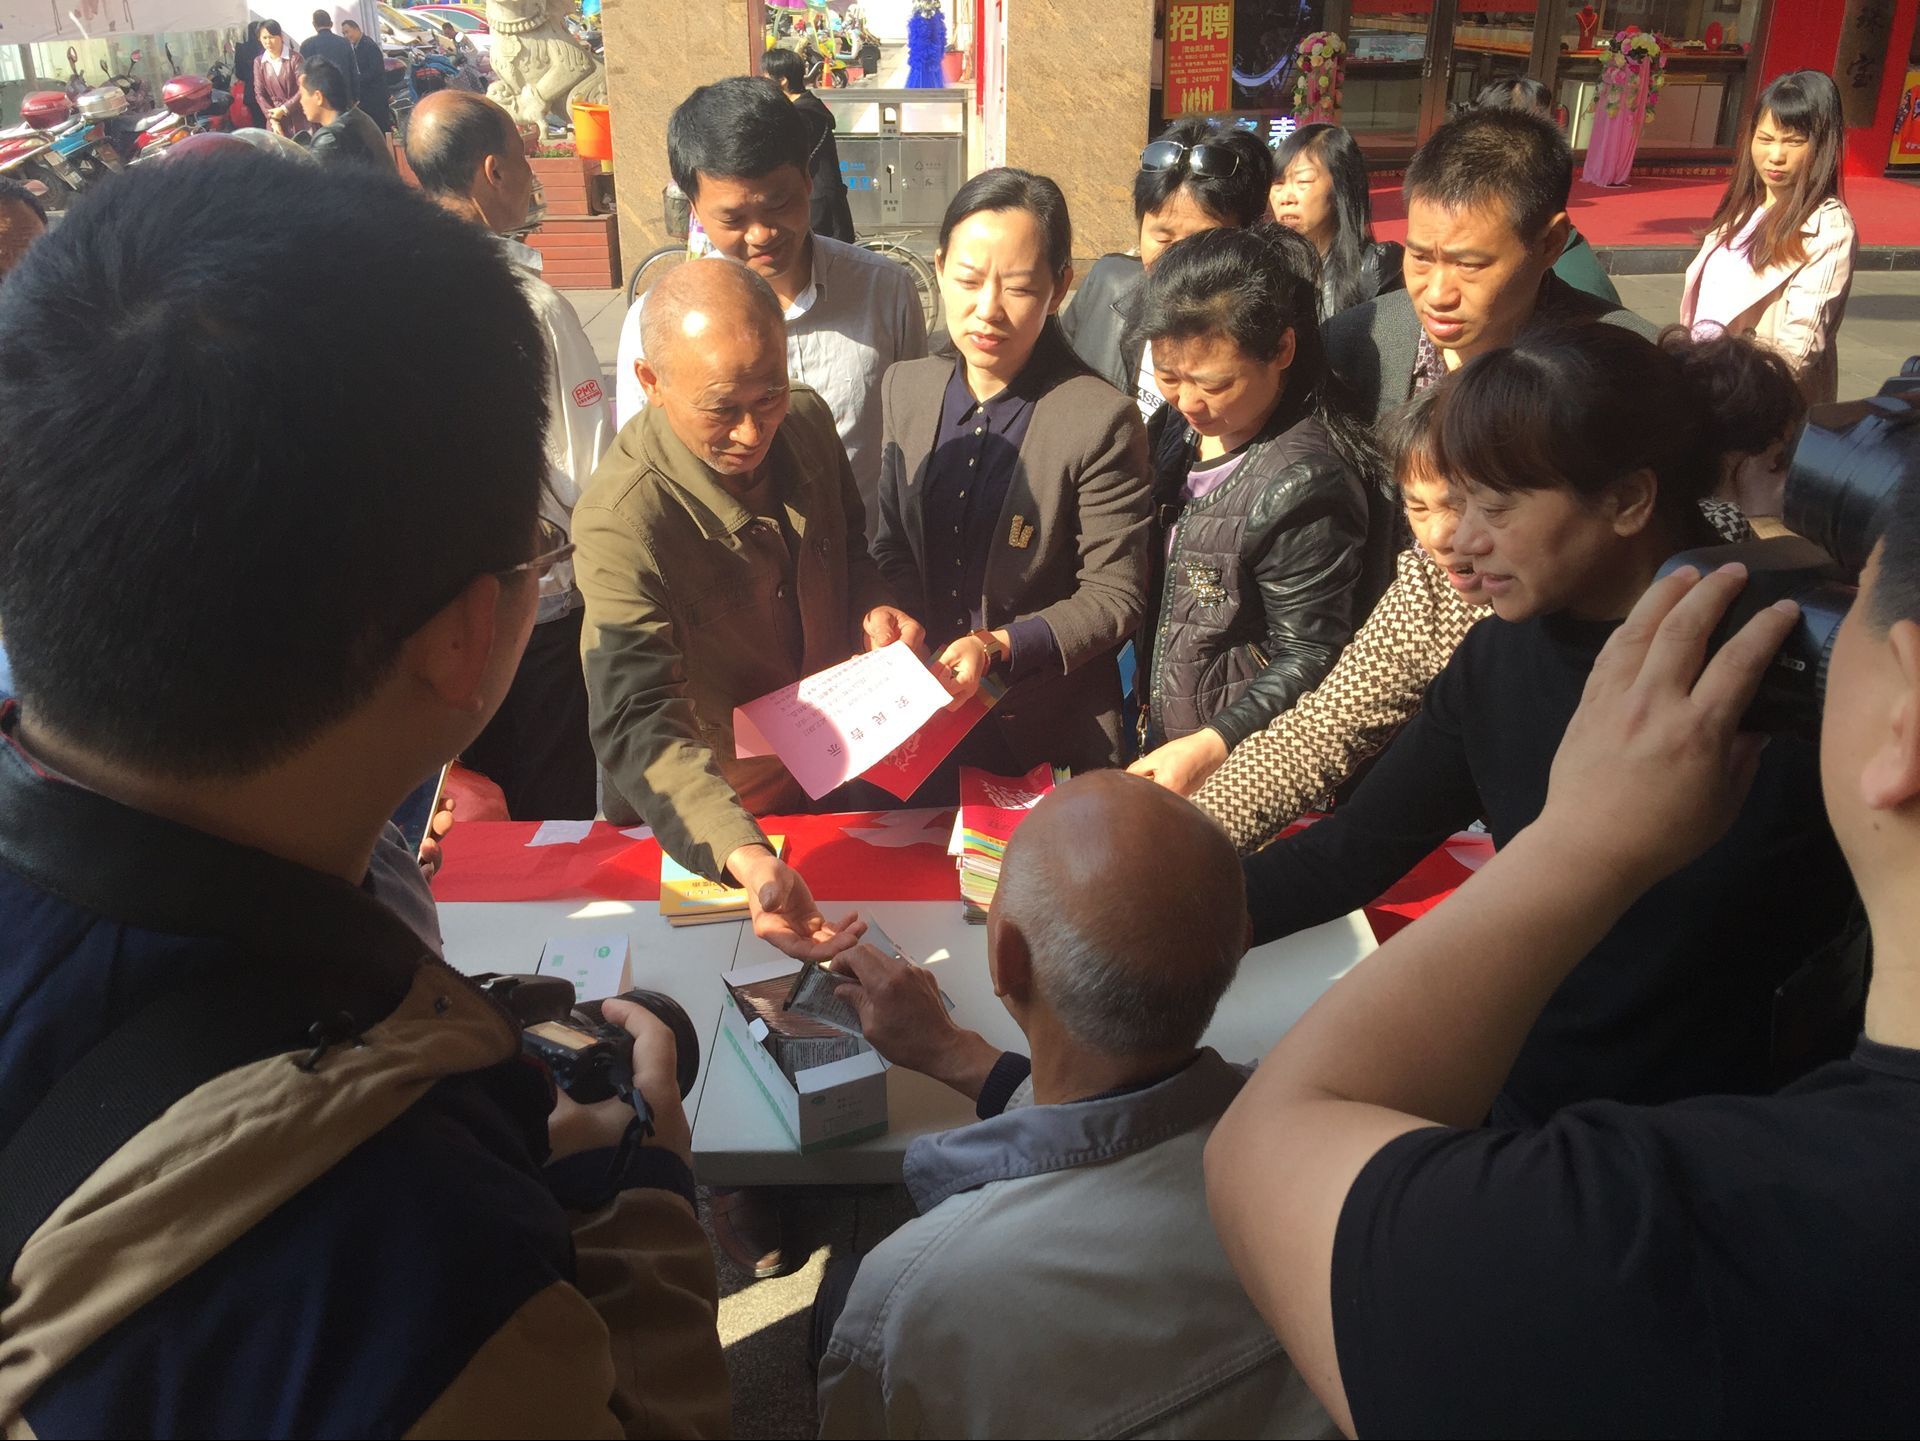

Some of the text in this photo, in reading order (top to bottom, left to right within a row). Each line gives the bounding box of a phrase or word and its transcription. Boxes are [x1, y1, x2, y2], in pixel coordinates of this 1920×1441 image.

[1170, 4, 1229, 41] 招聘
[575, 382, 596, 399] PMP
[826, 695, 909, 757] 安民告示
